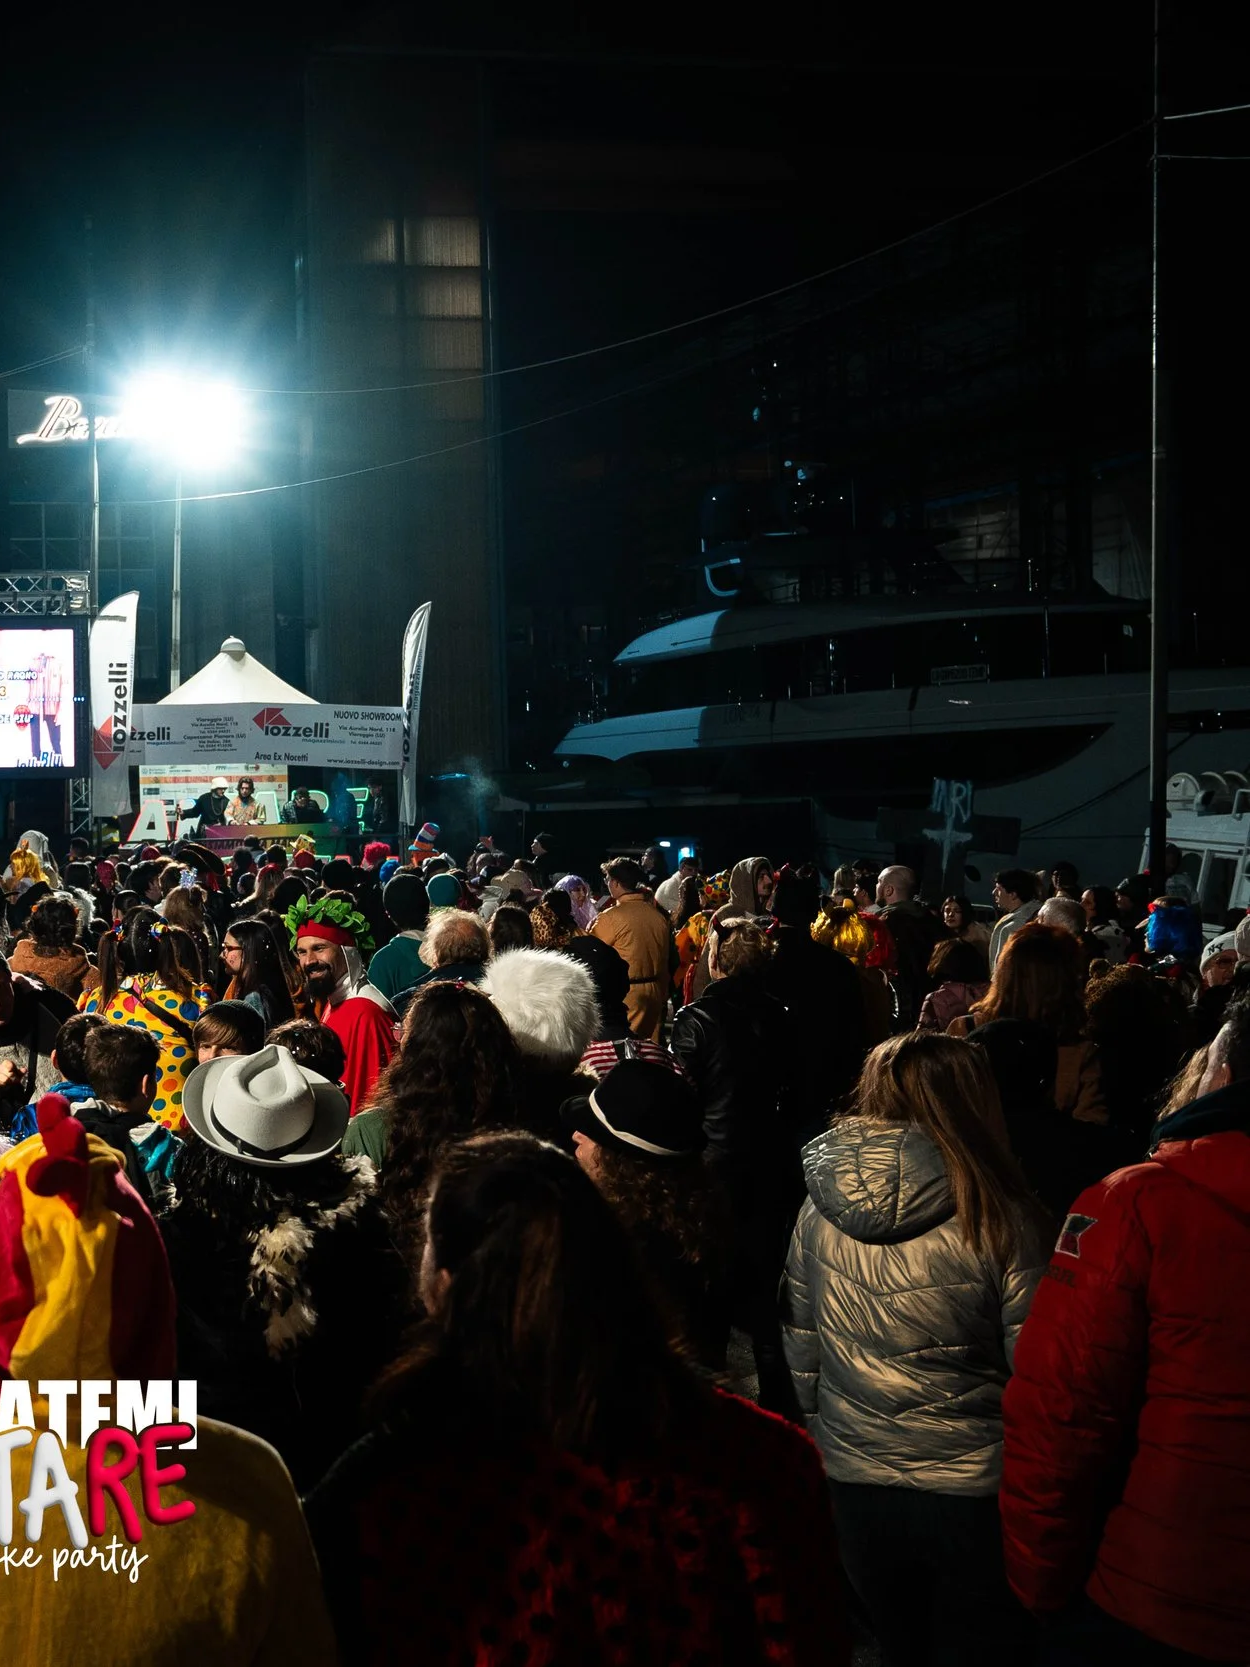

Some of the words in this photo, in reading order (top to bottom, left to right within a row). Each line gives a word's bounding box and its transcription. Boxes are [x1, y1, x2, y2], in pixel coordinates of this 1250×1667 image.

[7, 670, 38, 681] RAGNO
[333, 710, 360, 721] NUOVO
[361, 711, 401, 722] SHOWROOM
[254, 752, 272, 761] Area
[273, 752, 282, 761] Ex
[284, 752, 309, 762] Nocetti
